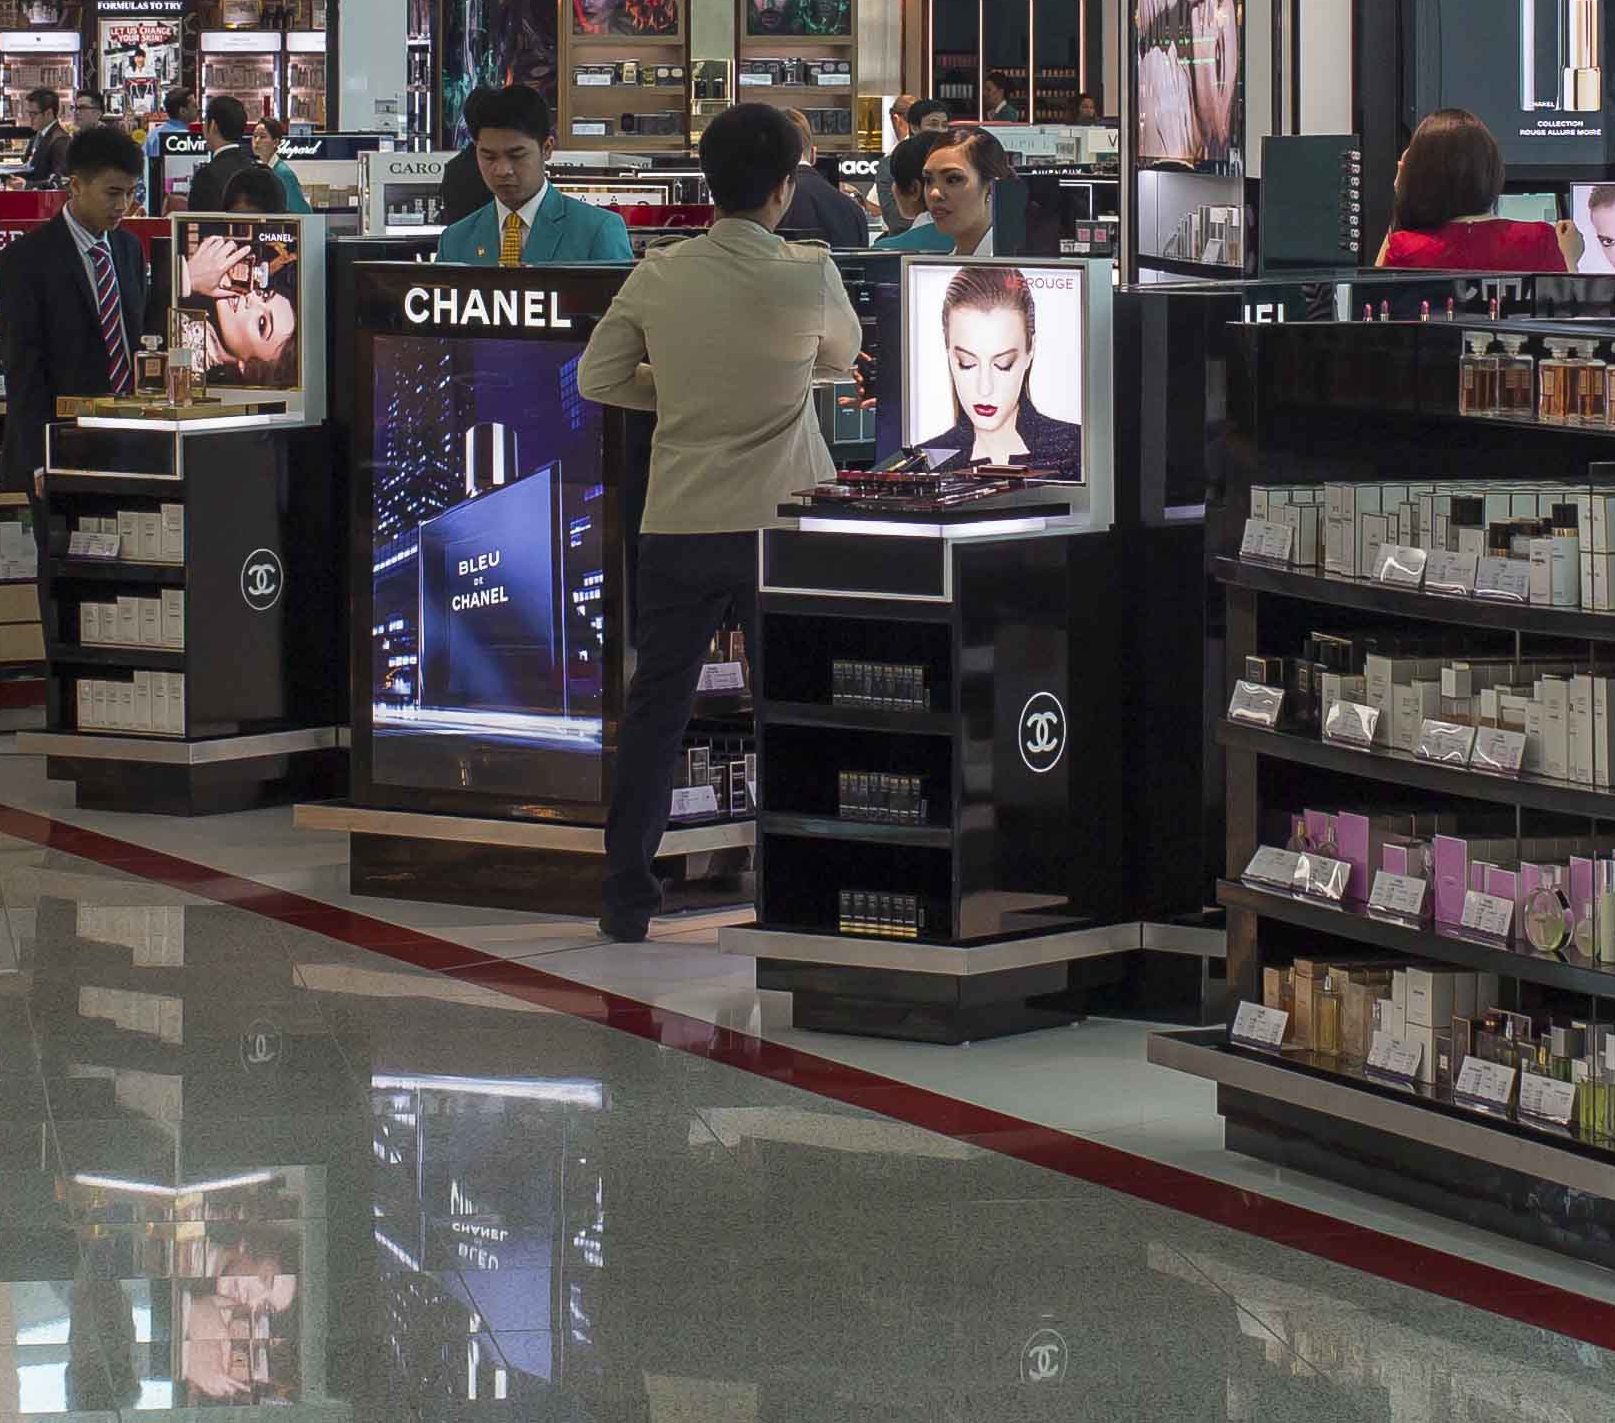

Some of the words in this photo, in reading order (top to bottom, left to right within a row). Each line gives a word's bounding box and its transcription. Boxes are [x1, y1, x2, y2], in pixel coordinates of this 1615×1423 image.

[97, 1, 148, 10] FORMULAS
[150, 1, 163, 10] TO
[165, 1, 183, 10] TRY
[1537, 120, 1584, 128] COLLECTION
[258, 233, 293, 242] CHANEL
[1026, 277, 1074, 290] ROUGE
[403, 287, 573, 328] CHANEL
[458, 549, 501, 576] BLEU
[451, 586, 509, 612] CHANEL
